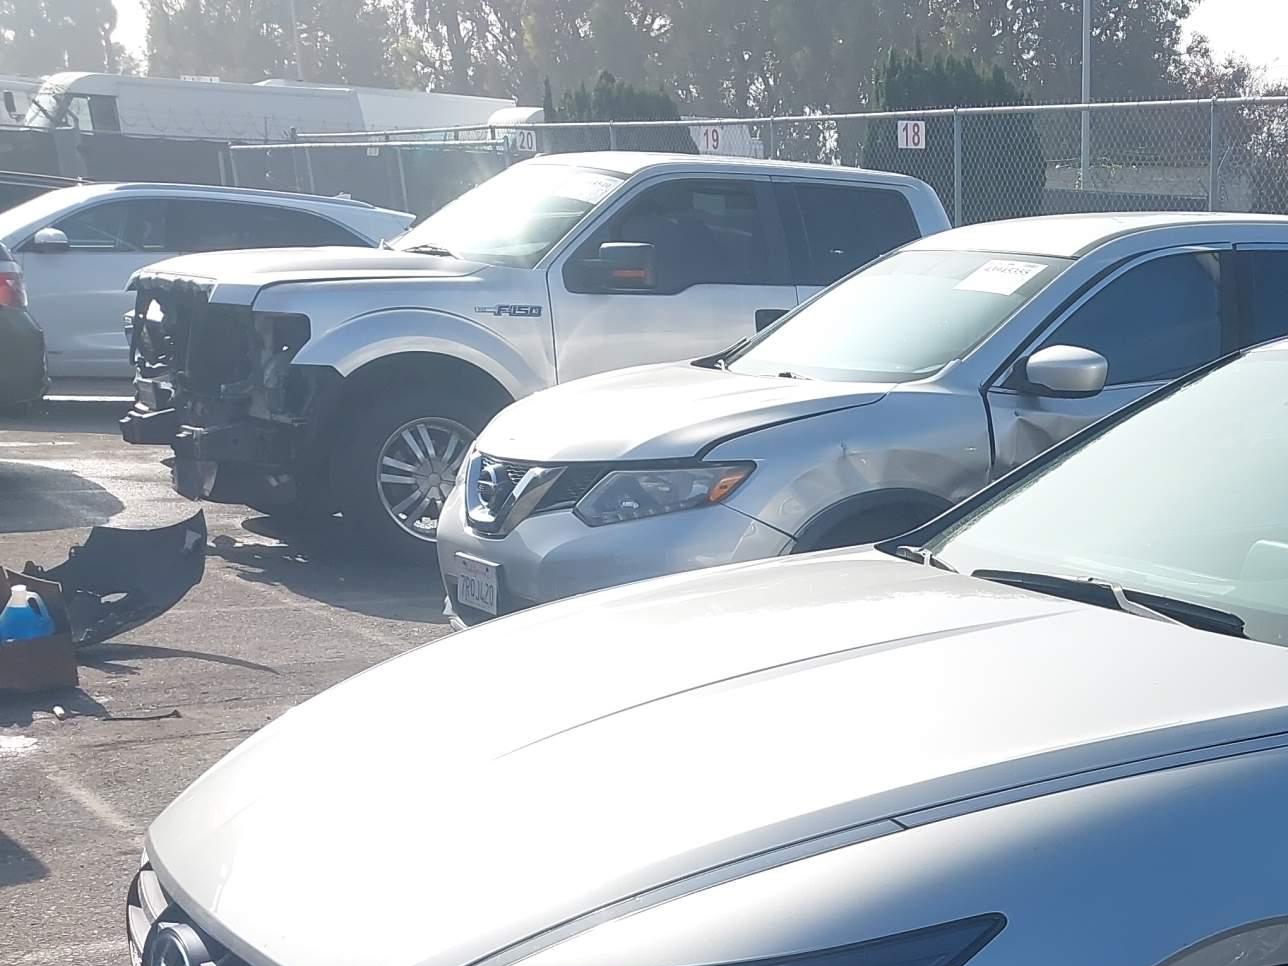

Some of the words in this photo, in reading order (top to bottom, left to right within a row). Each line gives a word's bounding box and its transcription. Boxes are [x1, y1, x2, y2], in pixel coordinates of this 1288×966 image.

[518, 131, 533, 150] 20
[703, 127, 720, 150] 19
[902, 122, 921, 147] 18
